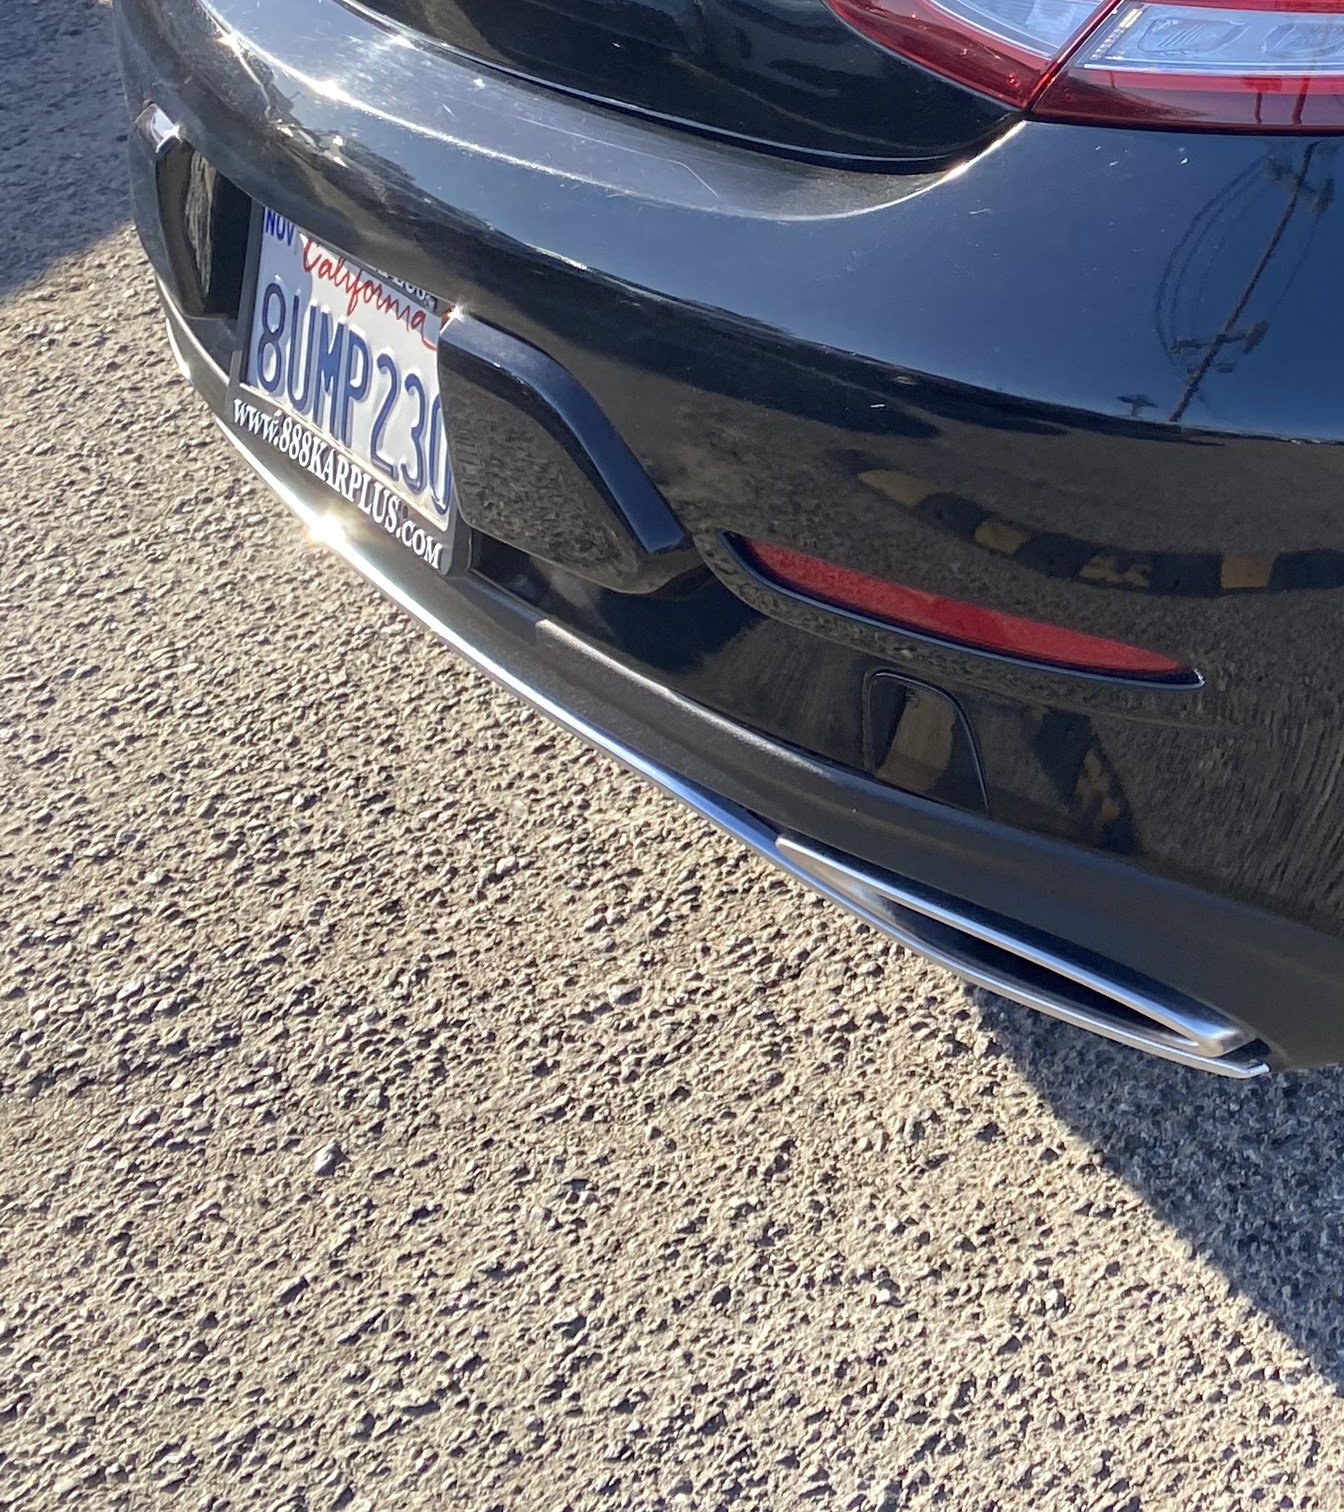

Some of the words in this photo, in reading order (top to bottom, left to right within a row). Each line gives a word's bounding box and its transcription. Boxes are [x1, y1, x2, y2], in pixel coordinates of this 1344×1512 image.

[264, 206, 296, 247] NOV
[302, 237, 438, 352] California
[257, 282, 451, 516] 8UMP230
